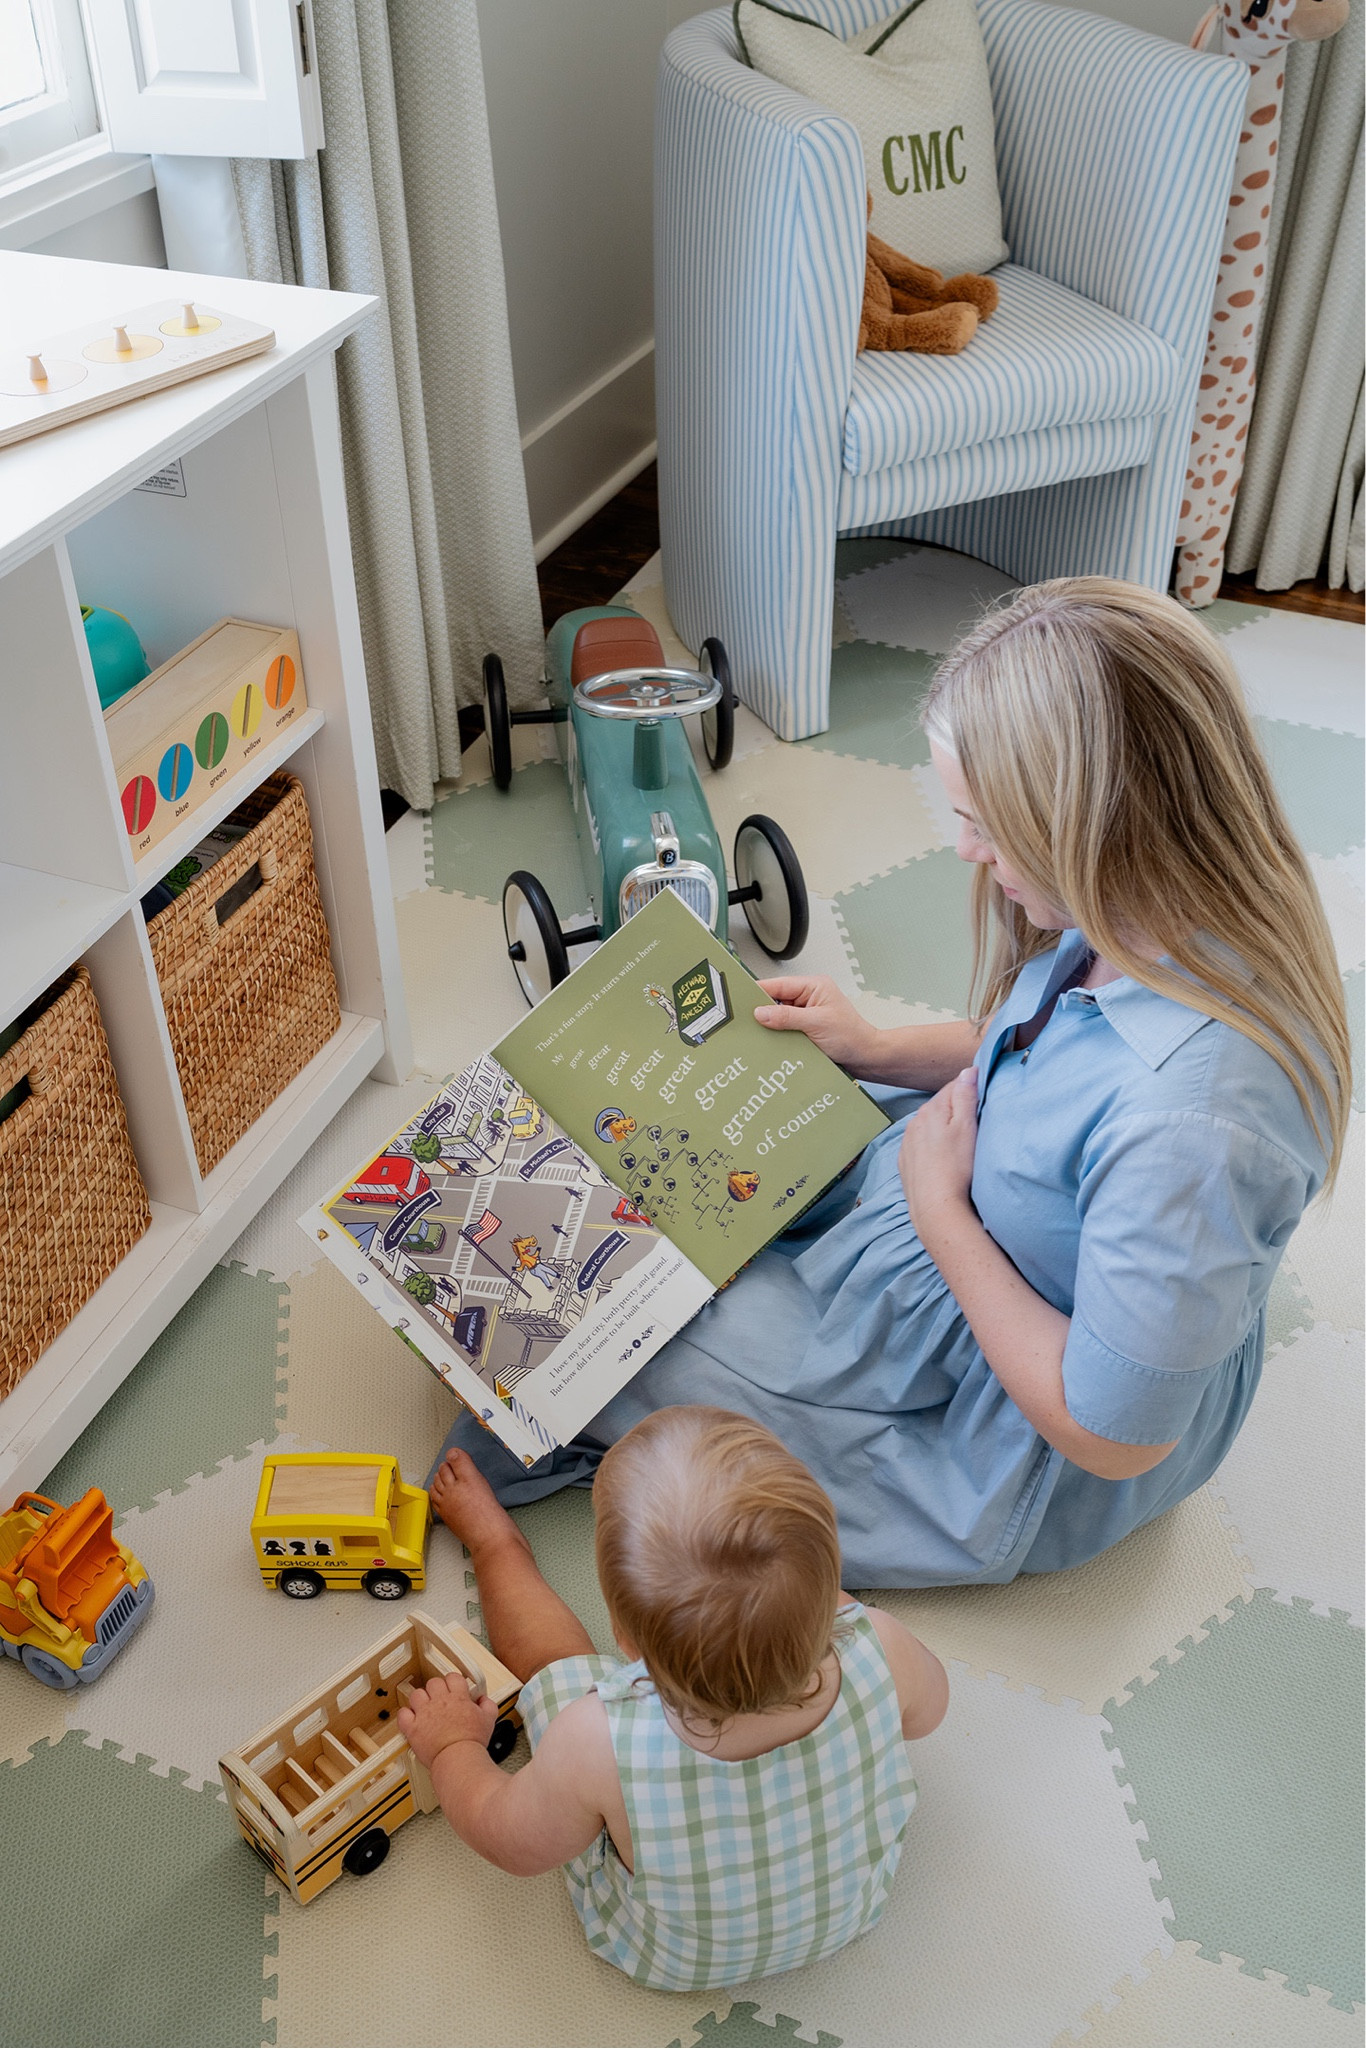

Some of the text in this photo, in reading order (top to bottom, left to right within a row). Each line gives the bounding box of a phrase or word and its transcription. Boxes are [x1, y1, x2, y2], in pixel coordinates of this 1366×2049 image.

[882, 125, 966, 195] CMC
[275, 707, 295, 727] orange
[243, 737, 262, 758] yellow
[209, 767, 228, 788] green
[175, 802, 189, 817] blue
[139, 835, 151, 849] red
[664, 852, 674, 862] B
[535, 1033, 559, 1052] That's
[562, 1016, 576, 1029] fun
[592, 993, 601, 1001] It
[600, 975, 620, 995] starts
[619, 960, 636, 977] with
[637, 939, 661, 959] horse.
[680, 994, 712, 1021] ANCESTRY
[551, 1043, 748, 1111] My great great great great great great
[424, 1106, 447, 1128] City Hall
[722, 1059, 804, 1146] grandpa,
[756, 1093, 841, 1155] of course.
[529, 1148, 553, 1168] Michael's
[389, 1197, 431, 1241] County Courthouse
[581, 1236, 621, 1286] Federal Courthouse
[553, 1359, 569, 1375] love
[567, 1348, 580, 1361] my
[578, 1335, 592, 1351] dear
[602, 1305, 621, 1323] both
[618, 1288, 639, 1309] pretty
[638, 1274, 652, 1290] and
[649, 1256, 669, 1278] grand.
[549, 1382, 564, 1397] But
[562, 1369, 577, 1385] how
[576, 1357, 589, 1371] did
[592, 1337, 610, 1354] come
[608, 1328, 618, 1337] to
[616, 1319, 626, 1330] be
[623, 1304, 641, 1322] built
[640, 1286, 659, 1305] where
[657, 1277, 668, 1287] we
